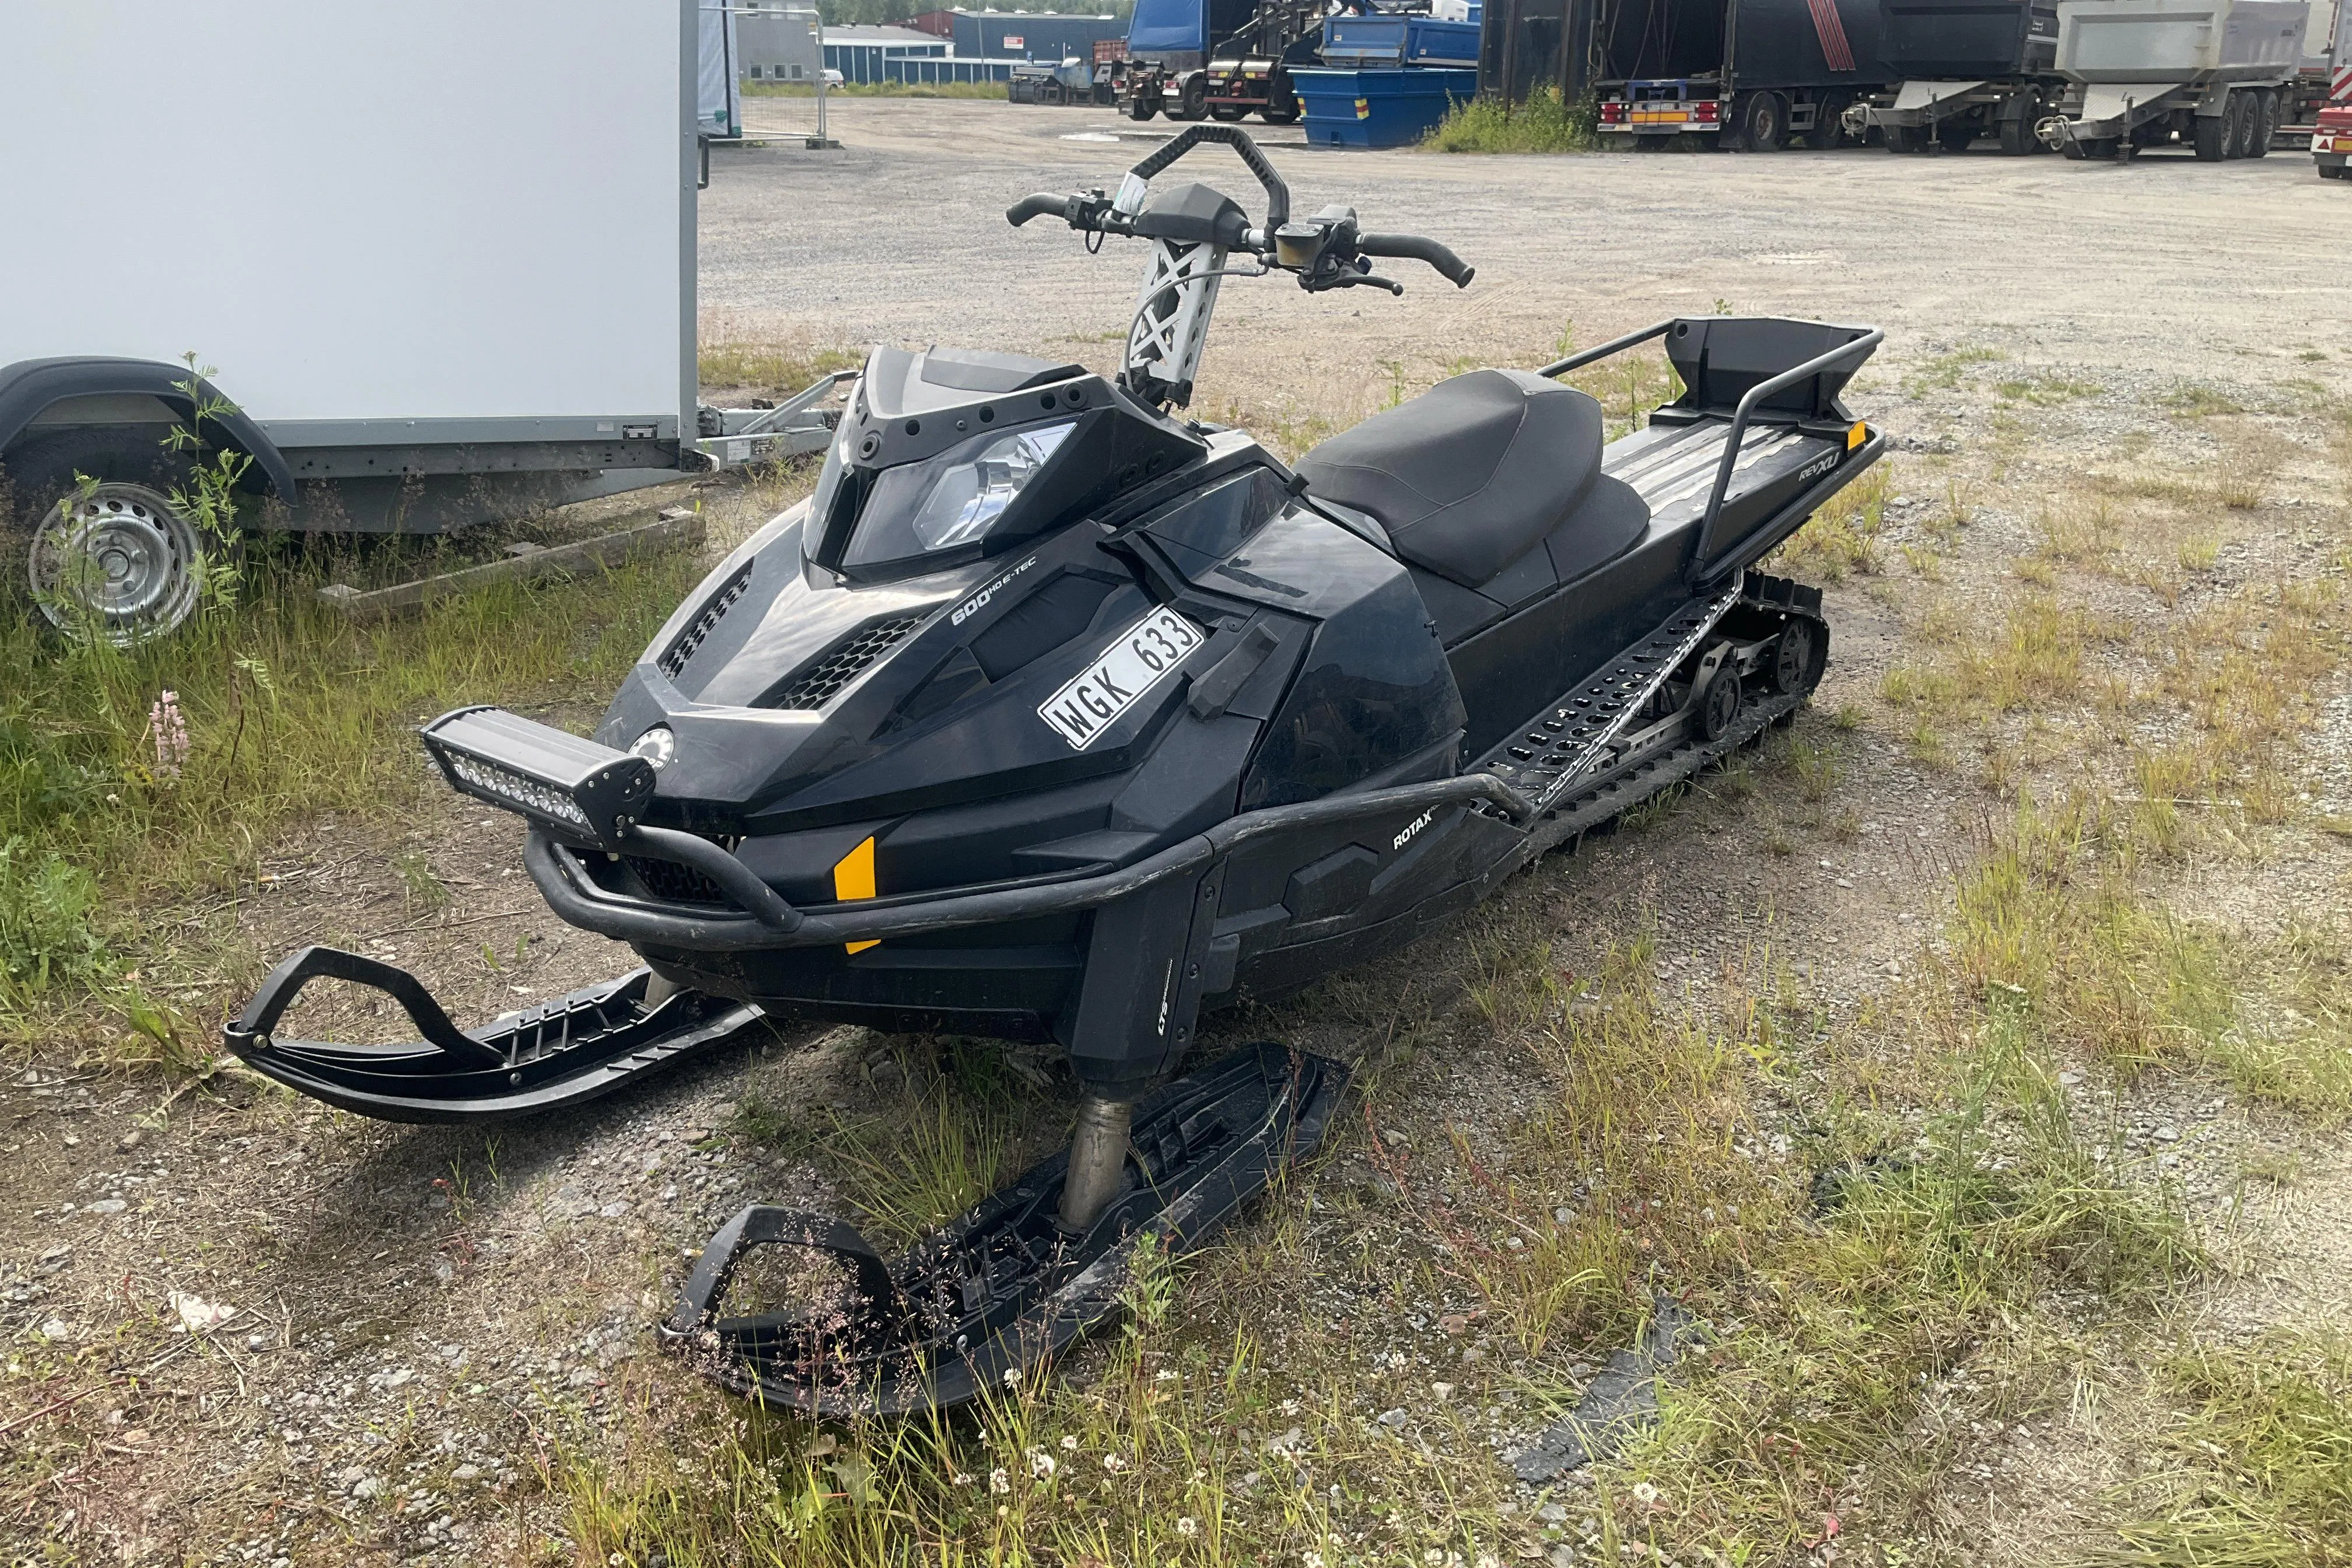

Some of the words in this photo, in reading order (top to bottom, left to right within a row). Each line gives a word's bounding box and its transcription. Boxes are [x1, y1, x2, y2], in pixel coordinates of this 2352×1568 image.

[1003, 556, 1036, 584] E-TEC
[1052, 666, 1133, 739] WGK
[1132, 615, 1193, 672] 633
[1393, 808, 1432, 850] ROTAX
